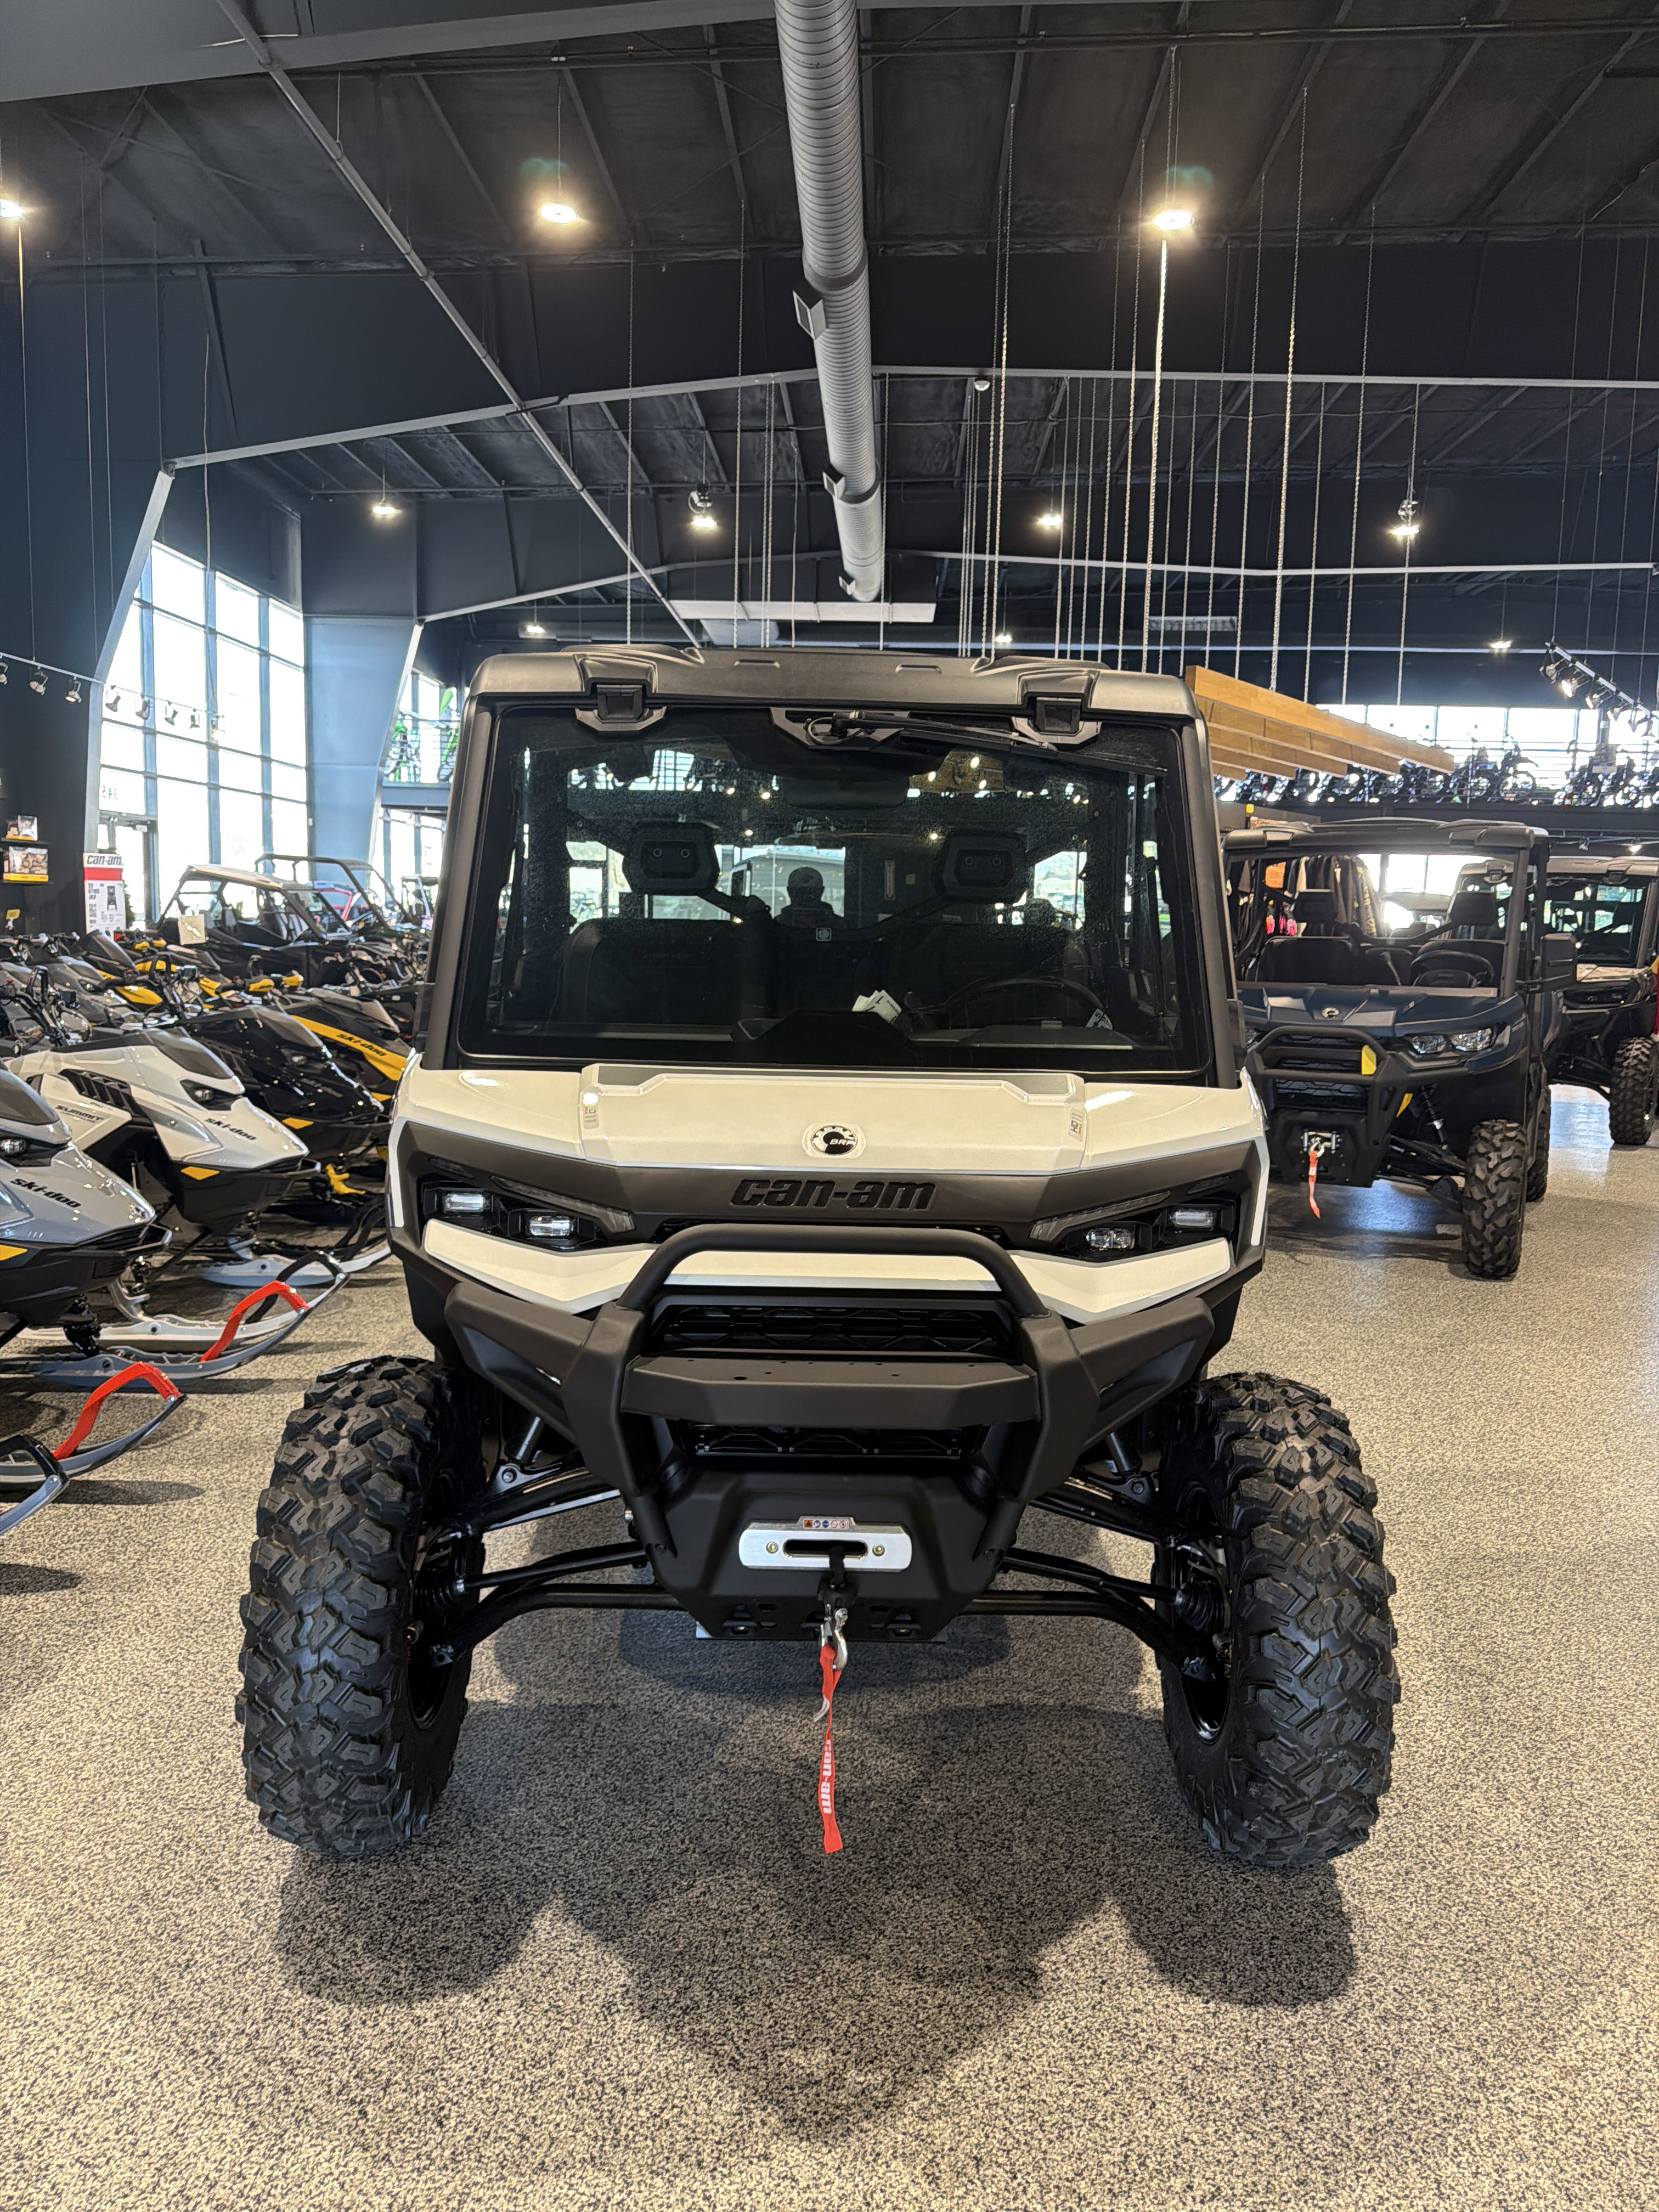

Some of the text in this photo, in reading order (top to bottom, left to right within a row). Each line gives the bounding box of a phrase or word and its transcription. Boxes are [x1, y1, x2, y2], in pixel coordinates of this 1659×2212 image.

[87, 855, 122, 865] can-am
[204, 1118, 257, 1141] ski-doo
[10, 1178, 82, 1208] ski-doo
[730, 1178, 936, 1210] can-am
